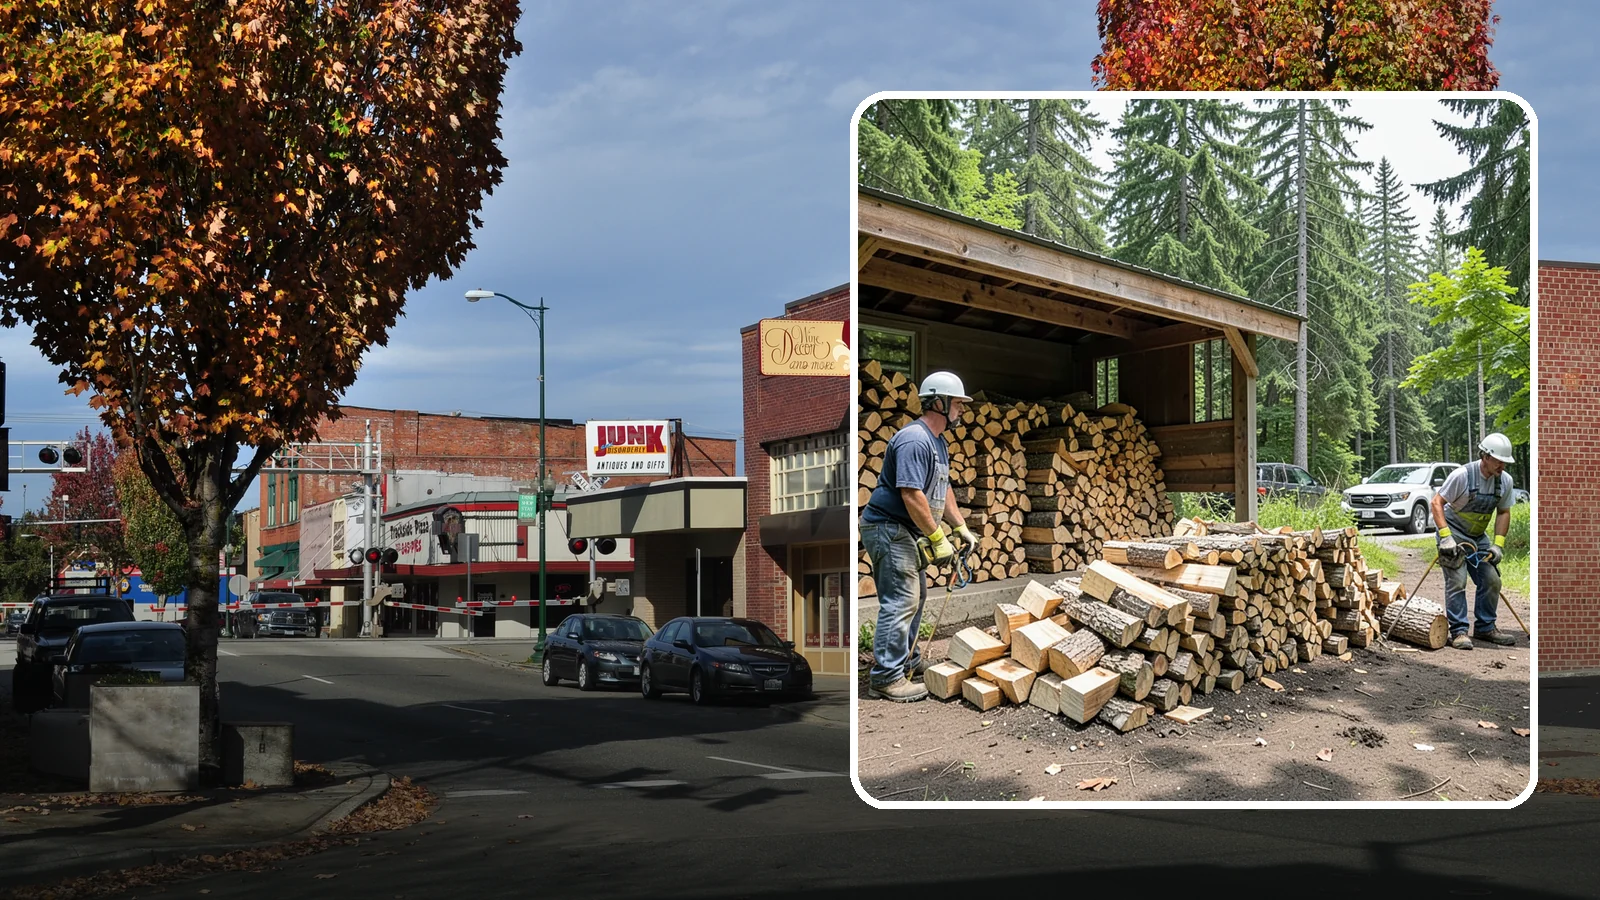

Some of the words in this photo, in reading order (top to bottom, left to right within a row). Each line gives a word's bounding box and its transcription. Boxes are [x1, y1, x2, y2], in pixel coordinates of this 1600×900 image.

[764, 328, 831, 365] Decor
[595, 425, 665, 457] JUNK
[607, 446, 646, 454] DISORDERLY
[597, 461, 628, 470] ANTIQUES
[631, 461, 644, 470] AND
[647, 461, 665, 469] GIFTS
[390, 521, 413, 540] Trackside
[414, 519, 429, 535] Pizza
